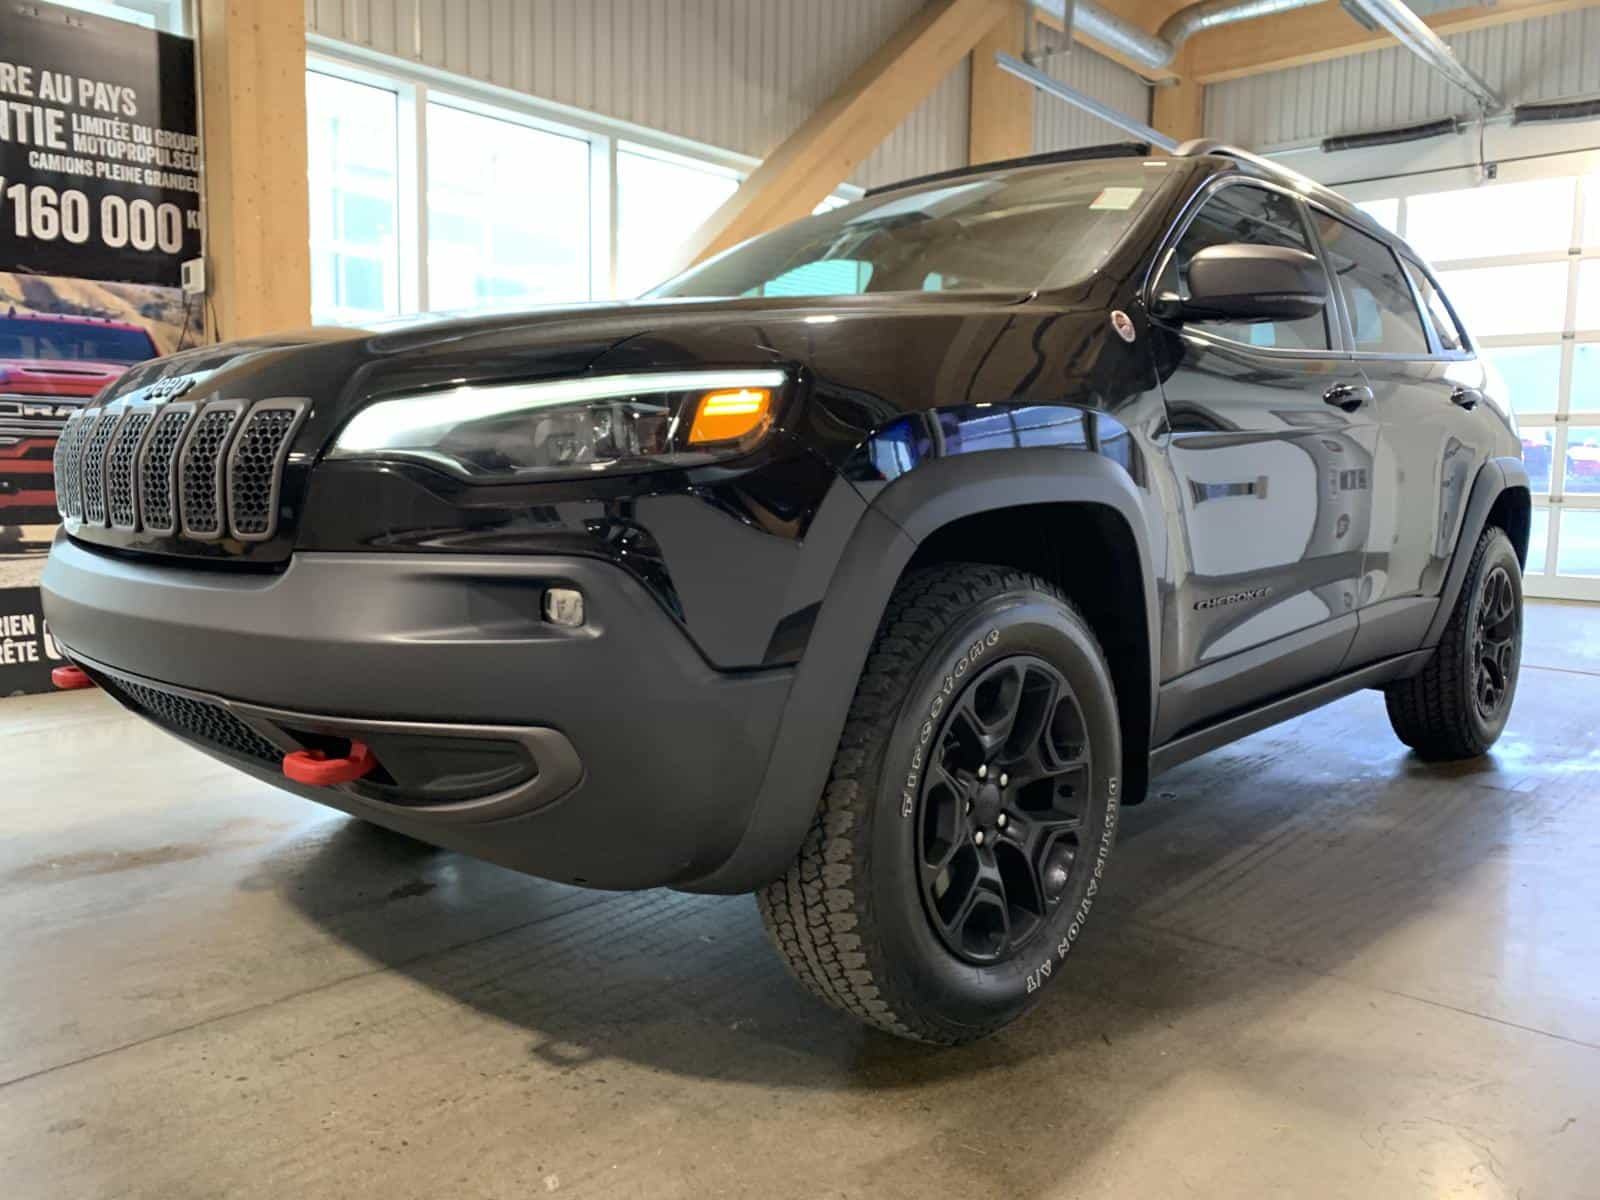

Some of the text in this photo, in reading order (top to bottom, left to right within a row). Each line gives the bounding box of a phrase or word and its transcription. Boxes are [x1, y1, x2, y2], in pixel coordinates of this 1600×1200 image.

[39, 70, 73, 105] AU
[78, 77, 137, 117] PAYS
[72, 113, 130, 142] LIMITÉE
[132, 123, 154, 145] DU
[28, 151, 94, 177] CAMIONS
[96, 160, 143, 184] PLEINE
[101, 194, 183, 255] 000
[1193, 586, 1273, 611] CHEROKEE
[0, 613, 36, 637] IEN
[0, 637, 40, 665] ÊTE
[1025, 777, 1119, 994] DESTINATION A/T
